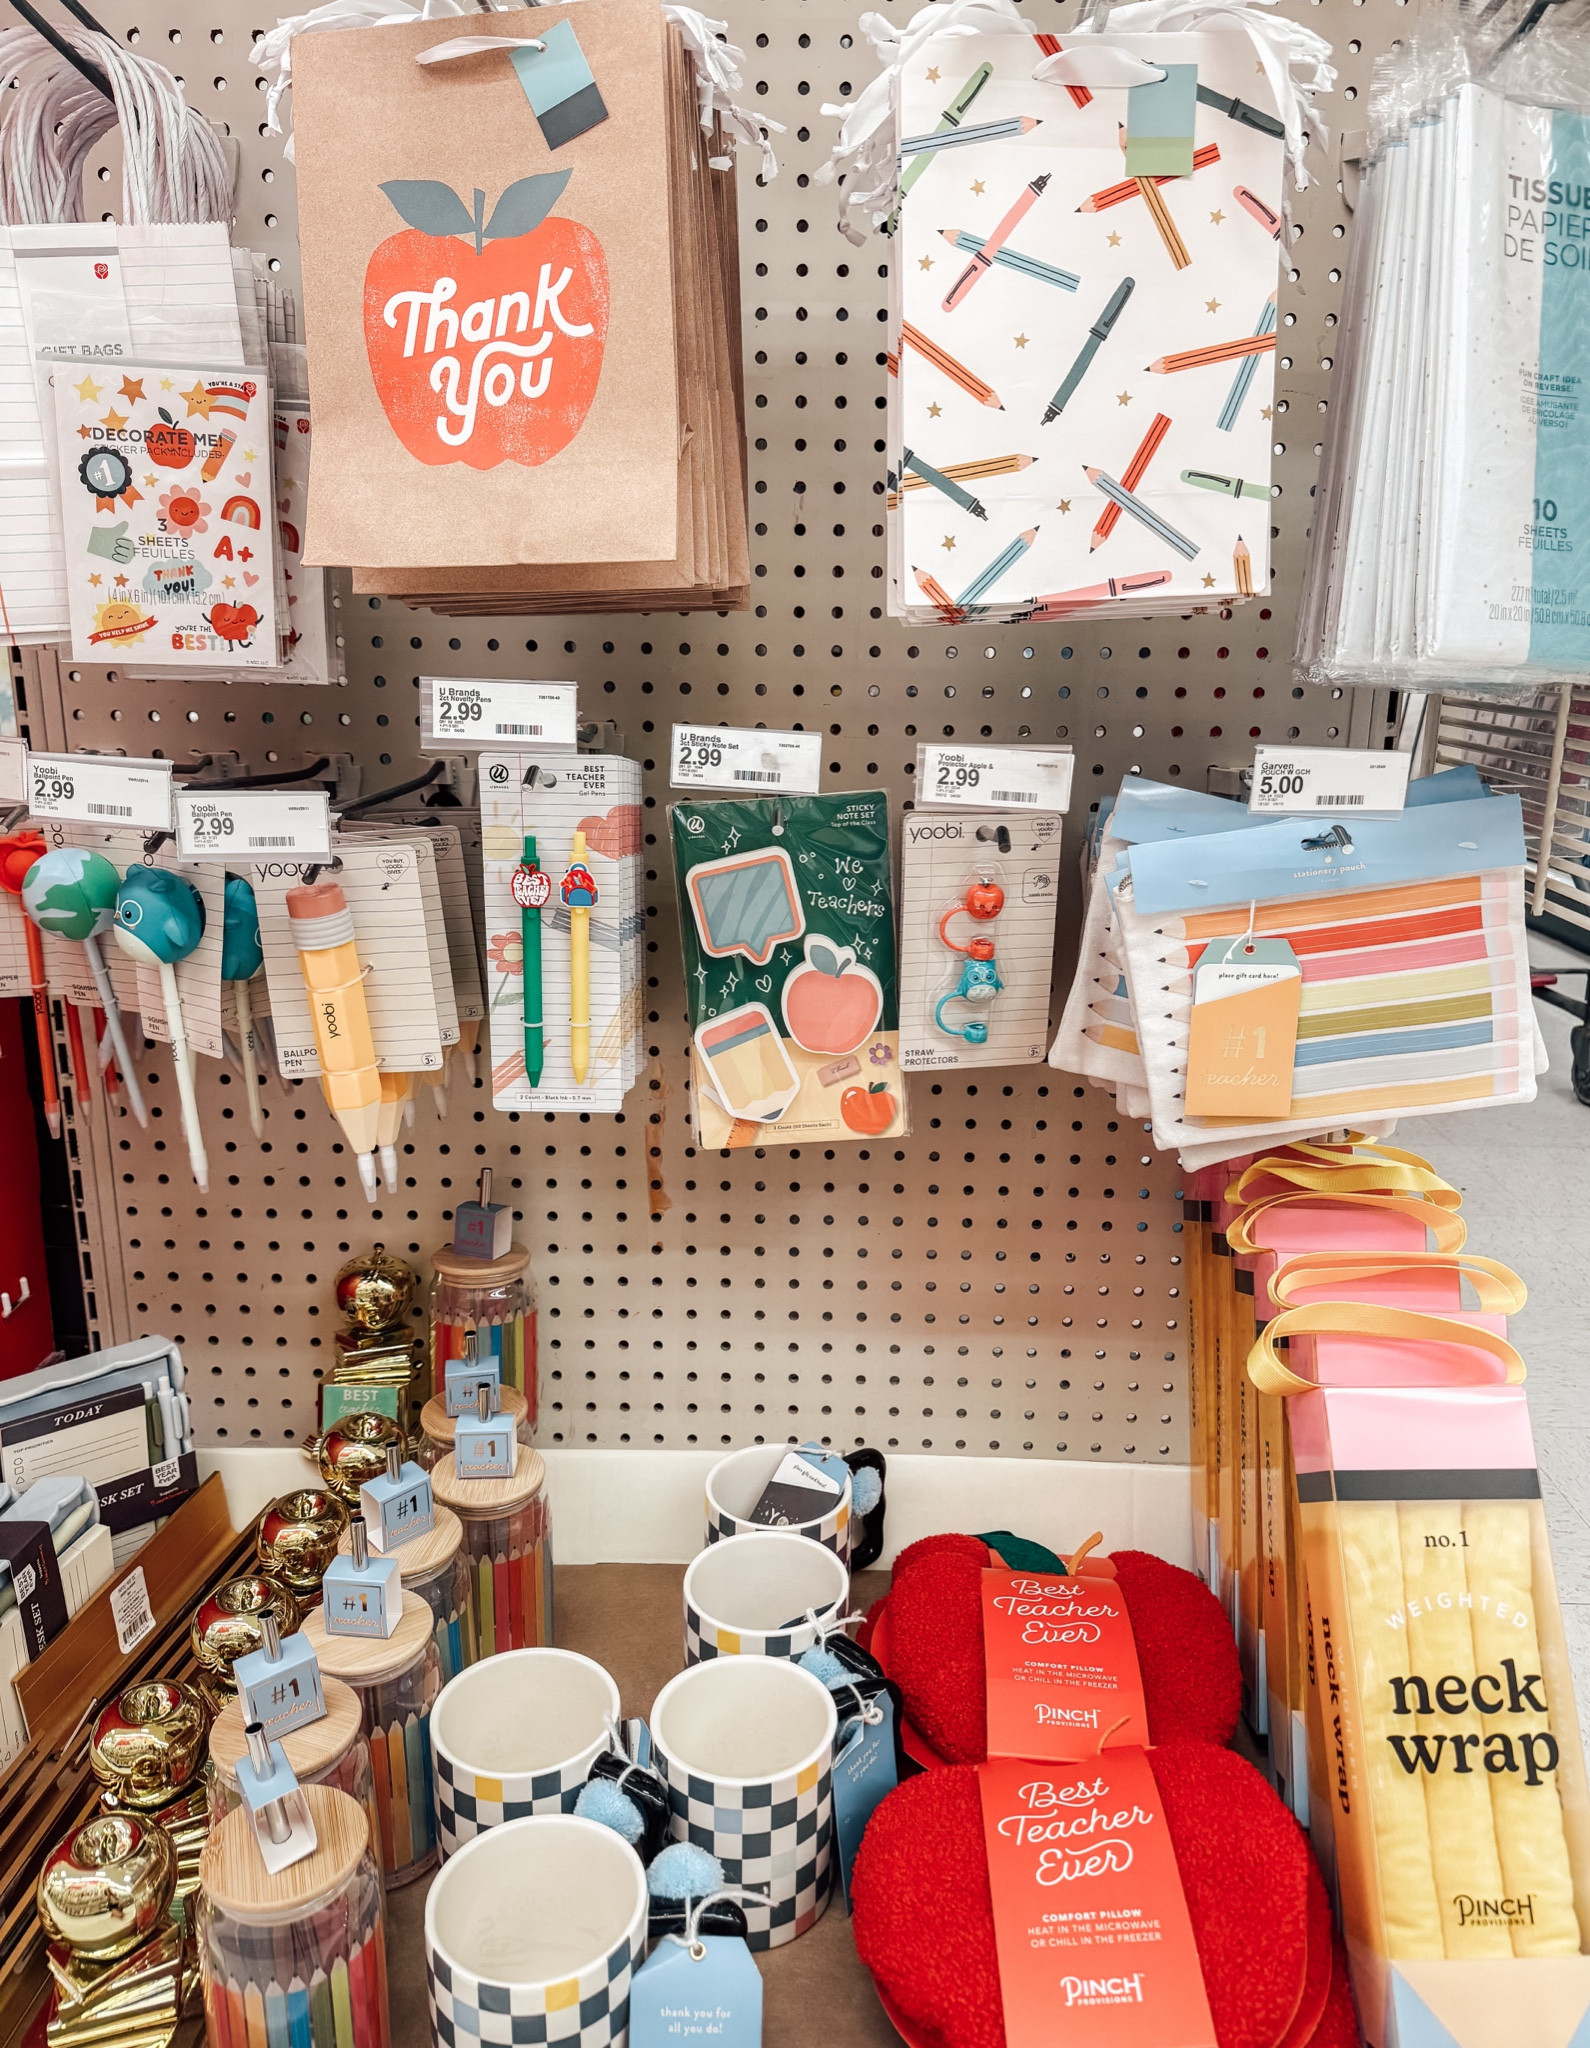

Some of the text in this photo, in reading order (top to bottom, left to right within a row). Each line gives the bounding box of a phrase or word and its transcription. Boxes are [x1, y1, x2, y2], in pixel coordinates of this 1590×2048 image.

[1508, 174, 1590, 210] TISSUE
[1503, 233, 1590, 271] DE SOI
[383, 263, 594, 358] Thank
[82, 343, 123, 356] BAGS
[1519, 368, 1582, 384] FUN CRAFT IDEA
[429, 331, 554, 446] You
[1523, 379, 1574, 392] ON REVERSE!
[1522, 405, 1575, 420] DE BRICOLAGE
[1536, 401, 1579, 411] AMUSANTE
[92, 427, 224, 447] DECORATE ME!
[140, 447, 167, 456] PACK
[93, 459, 116, 486] #1
[1533, 498, 1557, 521] 10
[158, 518, 168, 532] 3
[1523, 524, 1568, 539] SHEETS
[138, 536, 189, 548] SHEETS
[214, 535, 254, 562] A+
[1518, 537, 1573, 551] FEUILLES
[134, 547, 195, 560] FEUILLES
[153, 565, 194, 582] THANK
[164, 578, 195, 596] YOU!
[98, 621, 150, 639] YOU HELP ME SHINE
[175, 625, 212, 633] YOU'RE THE
[439, 688, 480, 697] U Brands
[440, 702, 482, 721] 2.99
[680, 732, 721, 743] U Brands
[679, 747, 722, 767] 2.99
[939, 753, 964, 762] Yoobi
[33, 765, 58, 775] Yoobi
[1261, 762, 1294, 770] Garven
[34, 772, 61, 781] Ballpoint
[566, 773, 605, 781] TEACHER
[583, 781, 605, 789] EVER
[937, 767, 980, 787] 2.99
[1260, 776, 1304, 794] 5.00
[34, 779, 75, 799] 2.99
[190, 804, 216, 812] Yoobi
[836, 811, 875, 820] NOTE SET
[846, 804, 875, 812] STICKY
[193, 817, 234, 836] 2.99
[834, 856, 864, 875] We
[1293, 862, 1366, 879] stationery pouch
[514, 873, 549, 886] BEST
[807, 890, 886, 918] Teachers
[1218, 973, 1235, 981] place
[1235, 972, 1248, 981] gift
[149, 1023, 160, 1031] PEN
[321, 1003, 341, 1039] yoobi
[1220, 1024, 1267, 1059] #1
[904, 1049, 935, 1057] STRAW
[904, 1056, 958, 1066] PROTECTORS
[284, 1059, 303, 1067] PEN
[343, 1389, 378, 1401] BEST
[53, 1404, 104, 1427] TODAY
[474, 1440, 496, 1458] #1
[155, 1461, 177, 1475] BEST
[156, 1467, 177, 1480] YEAR
[465, 1460, 504, 1472] teacher
[158, 1474, 177, 1484] EVER
[120, 1482, 145, 1500] SET
[396, 1495, 418, 1519] #1
[390, 1514, 429, 1538] teacher
[17, 1577, 26, 1599] BEST
[1010, 1579, 1085, 1600] Best
[342, 1593, 368, 1612] #1
[993, 1596, 1119, 1617] Teacher
[30, 1602, 42, 1626] SET
[1384, 1592, 1529, 1631] WEIGHTED
[333, 1614, 379, 1629] teacher
[1021, 1620, 1101, 1644] Ever
[1012, 1667, 1033, 1675] HEAT
[1066, 1671, 1118, 1682] MICROWAVE
[1024, 1661, 1104, 1673] COMFORT PILLOW
[271, 1677, 300, 1705] #1
[1028, 1676, 1051, 1684] CHILL
[1083, 1681, 1118, 1689] FREEZER
[1388, 1658, 1549, 1716] neck
[264, 1700, 314, 1728] teacher
[1033, 1703, 1099, 1729] PINCH
[1322, 1616, 1350, 1815] neck wrap
[1046, 1719, 1090, 1728] PROVISIONS
[1387, 1730, 1560, 1787] wrap
[1018, 1777, 1110, 1809] Best
[997, 1805, 1153, 1846] Teacher
[1036, 1839, 1133, 1886] Ever
[1042, 1909, 1142, 1923] COMFORT PILLOW
[1453, 1894, 1535, 1926] PINCH
[1027, 1919, 1161, 1936] HEAT IN THE MICROWAVE
[1470, 1918, 1526, 1926] PROVISIONS
[1030, 1932, 1162, 1949] OR CHILL IN THE FREEZER
[1060, 1973, 1143, 2007] PINCH
[1077, 1995, 1133, 2006] PROVISIONS
[660, 2007, 731, 2020] thank you for
[668, 2022, 723, 2036] all you do!
